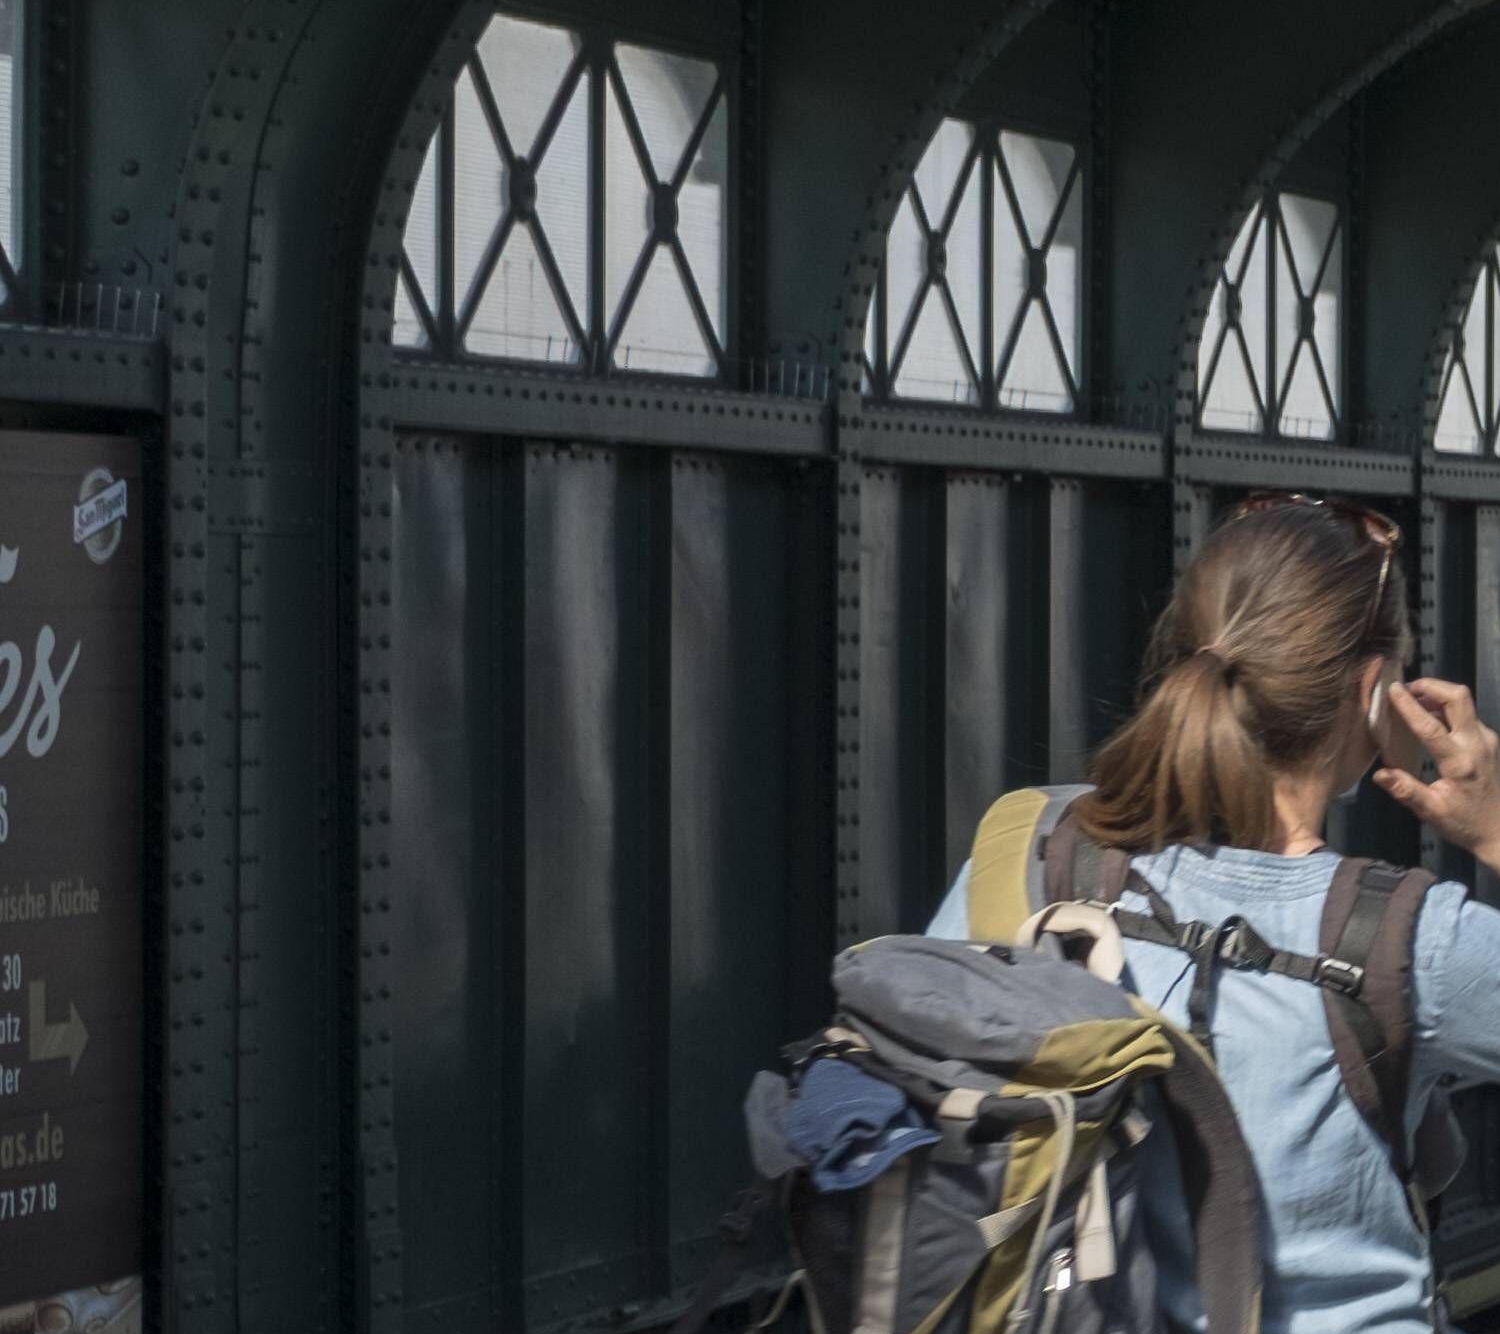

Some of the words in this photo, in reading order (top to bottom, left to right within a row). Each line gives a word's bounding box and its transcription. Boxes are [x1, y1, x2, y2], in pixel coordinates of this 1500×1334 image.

[0, 880, 46, 923] ische
[50, 877, 100, 917] Küche
[2, 953, 22, 991] 30
[20, 1185, 37, 1216] 57
[41, 1181, 57, 1211] 18
